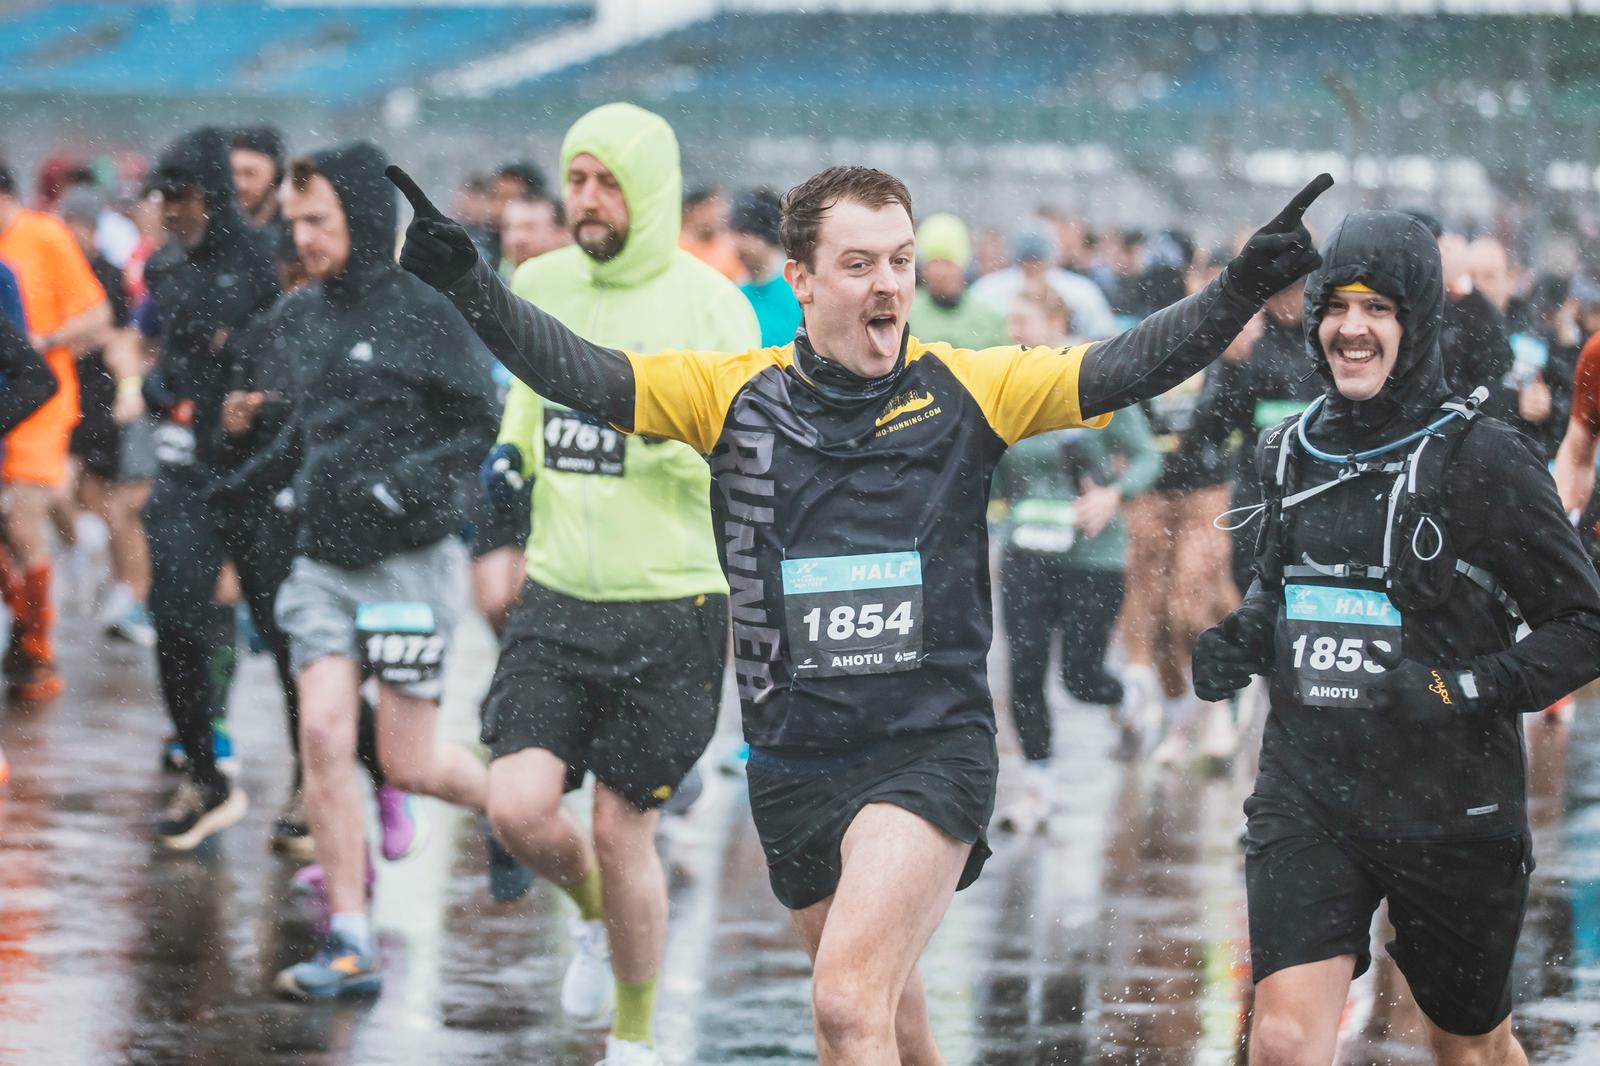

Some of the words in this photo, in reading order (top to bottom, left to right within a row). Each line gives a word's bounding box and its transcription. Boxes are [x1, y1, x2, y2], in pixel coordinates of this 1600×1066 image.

[875, 406, 942, 438] MO-RUNNING.COM
[711, 428, 782, 703] RUNNER
[850, 560, 914, 581] HALF
[1335, 596, 1393, 617] HALF
[803, 601, 914, 642] 1854
[831, 653, 884, 668] AHOTU
[1308, 685, 1359, 700] AHOTU
[1428, 670, 1454, 704] parkrun
